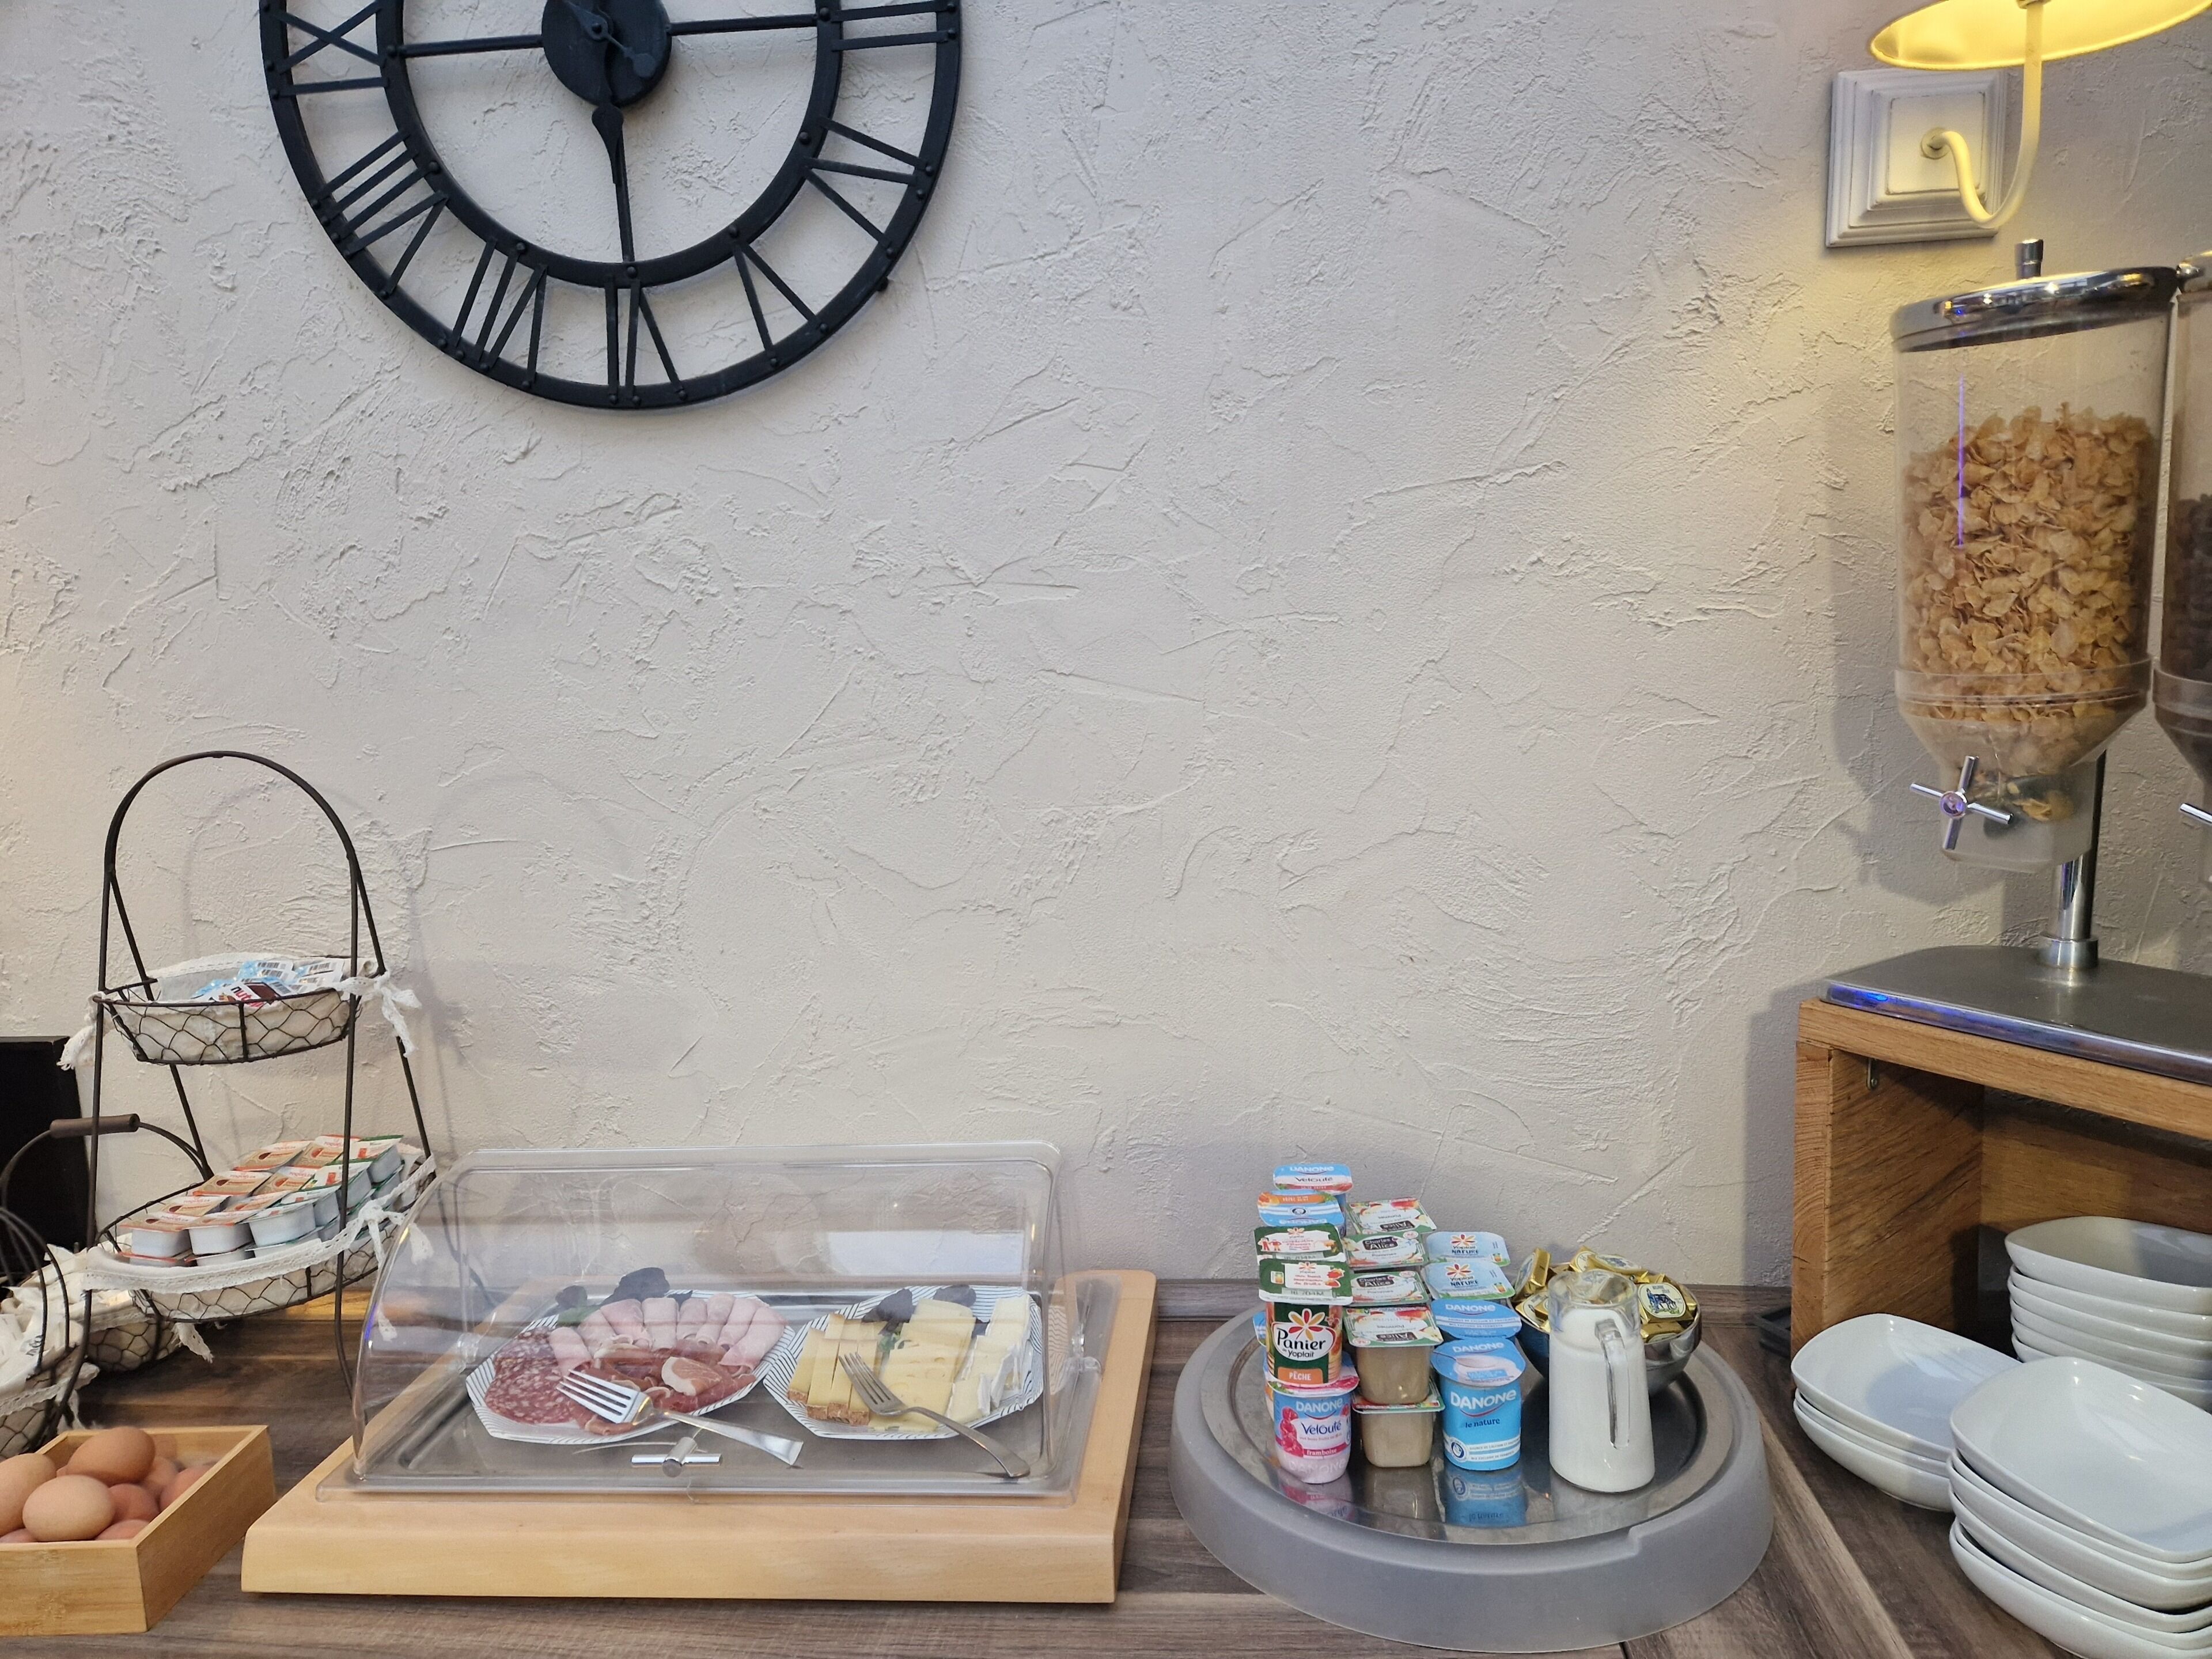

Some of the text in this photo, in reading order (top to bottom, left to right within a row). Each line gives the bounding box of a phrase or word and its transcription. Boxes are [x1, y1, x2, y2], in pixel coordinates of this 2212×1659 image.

[1445, 1304, 1496, 1312] DANONE
[1277, 1327, 1326, 1350] Panier
[1452, 1342, 1505, 1353] DANONE
[1288, 1349, 1315, 1358] Yoplait
[1289, 1371, 1312, 1381] PÊCHE
[1450, 1389, 1517, 1410] DANONE
[1297, 1397, 1343, 1413] DANONE
[1301, 1420, 1342, 1435] Velouté
[1474, 1418, 1501, 1427] nature
[1306, 1448, 1337, 1456] framboise
